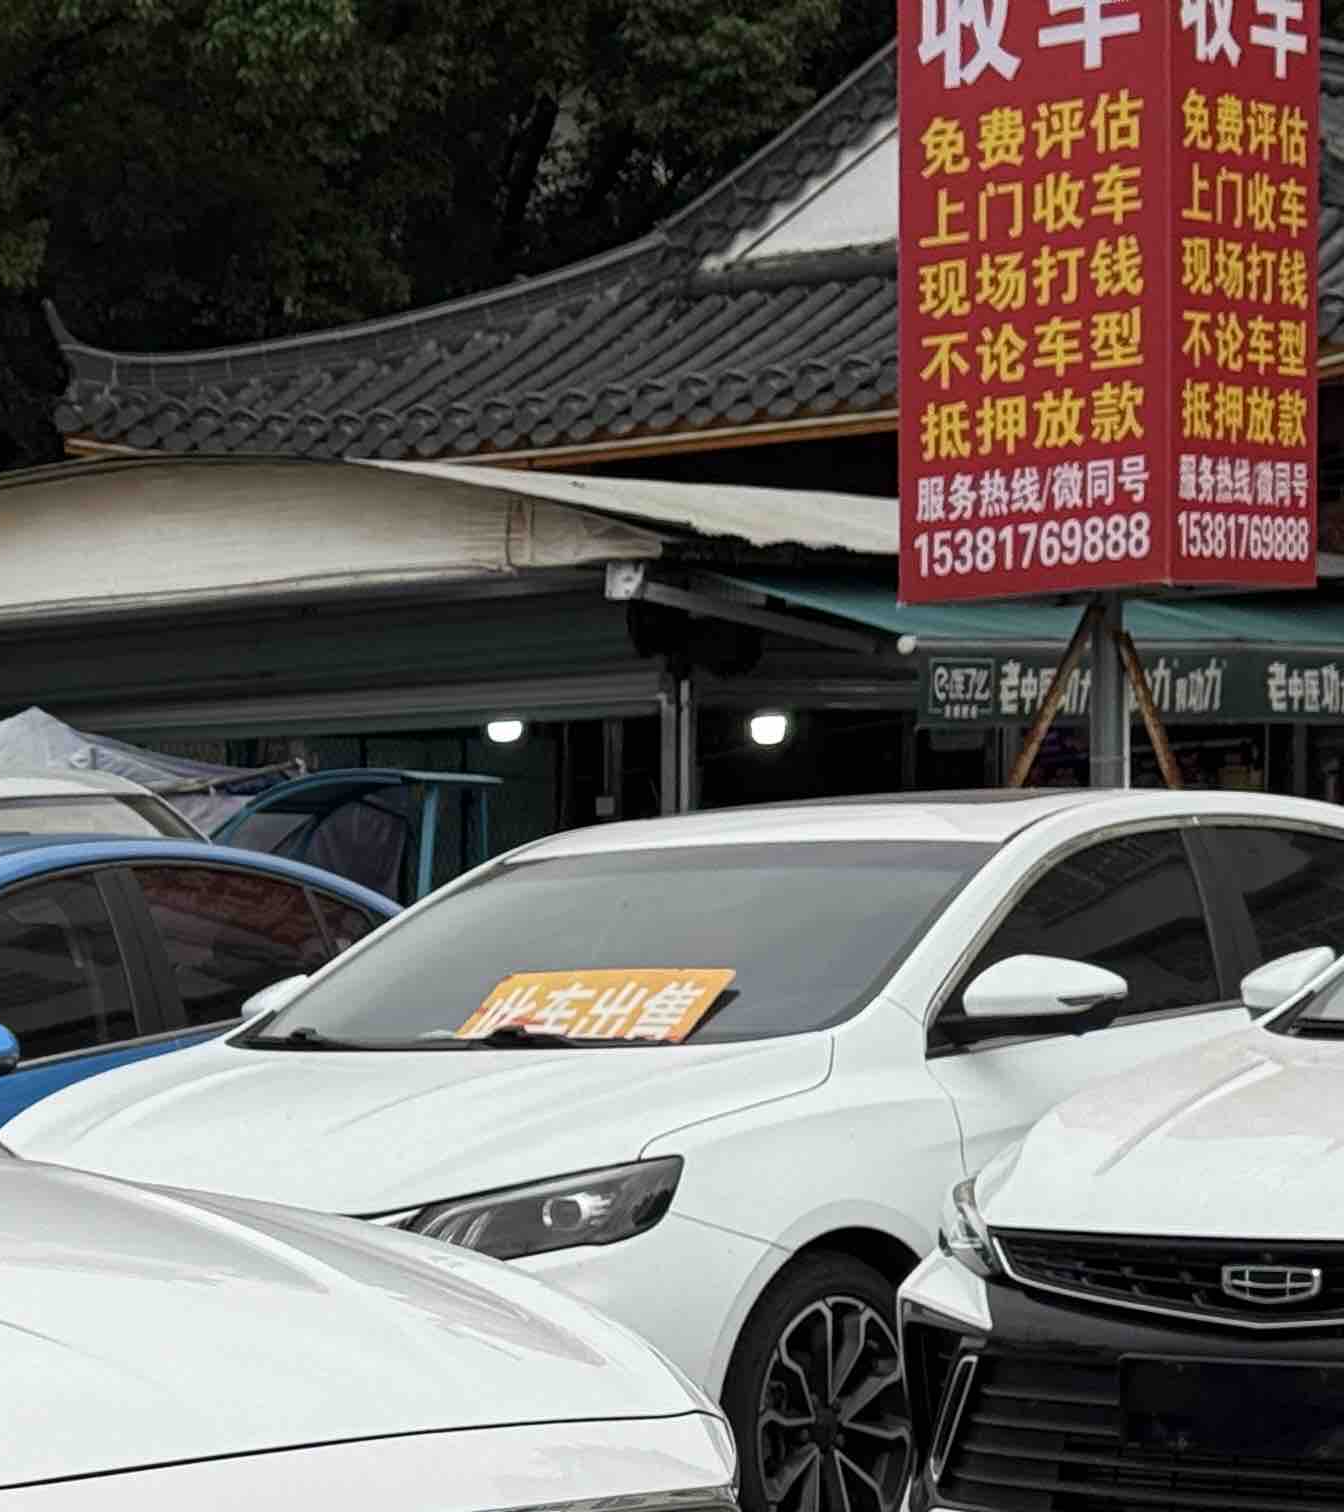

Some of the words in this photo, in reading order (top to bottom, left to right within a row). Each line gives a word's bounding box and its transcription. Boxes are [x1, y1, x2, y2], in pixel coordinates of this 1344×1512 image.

[919, 88, 1144, 178] 免费评估
[1181, 88, 1309, 169] 免费评估
[918, 164, 1144, 249] 上门收车
[1181, 163, 1309, 238] 上门收车
[918, 234, 1144, 320] 现场打钱
[1181, 236, 1309, 310] 现场打钱
[919, 306, 1144, 389] 不论车型
[1181, 310, 1308, 378] 不论车型
[919, 381, 1145, 462] 抵押放款
[1181, 379, 1308, 447] 抵押放款
[916, 454, 1150, 522] 服务热线/微同号
[1178, 454, 1310, 509] 服务热线/微同号
[913, 512, 1151, 577] 15381769888
[1177, 511, 1310, 563] 15381769888
[470, 980, 707, 1041] 此车出售
